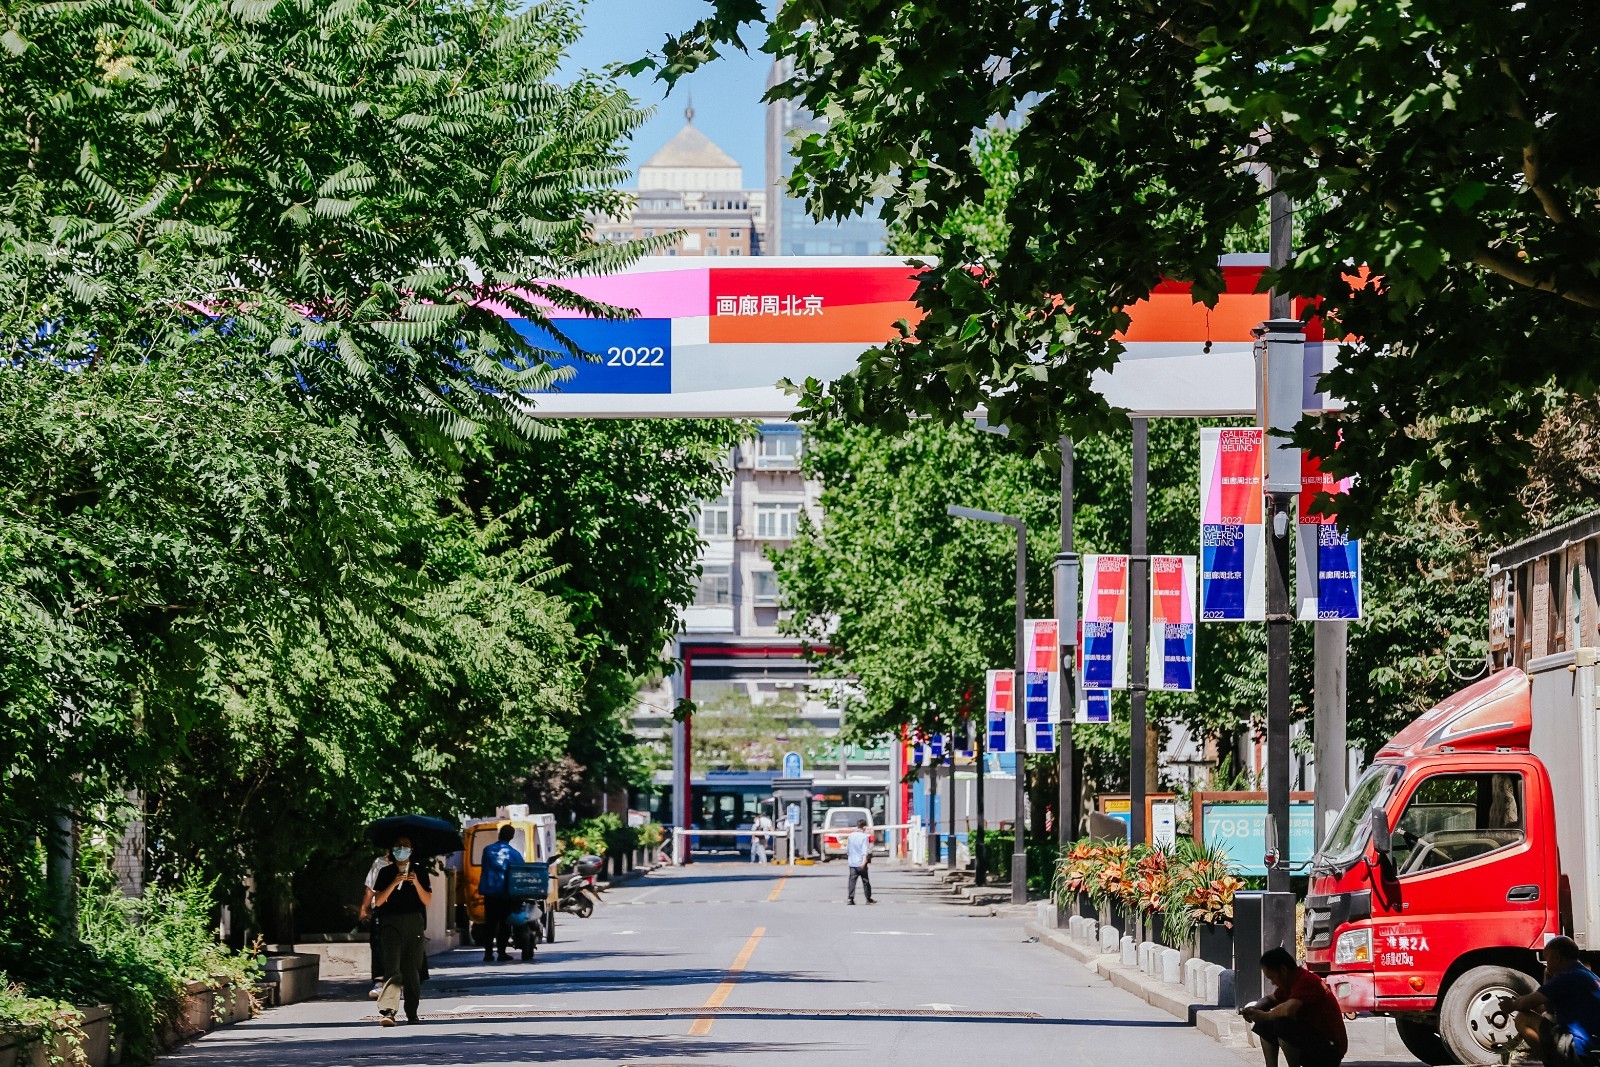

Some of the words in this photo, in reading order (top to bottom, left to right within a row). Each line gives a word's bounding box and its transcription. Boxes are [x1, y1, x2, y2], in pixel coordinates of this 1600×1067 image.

[715, 294, 824, 317] 画廊周北京
[606, 346, 665, 367] 2022
[1221, 430, 1259, 438] GALLERY
[1221, 437, 1262, 445] WEEKEND
[1221, 444, 1253, 452] BEIJING
[1221, 516, 1242, 524] 2022
[1299, 516, 1321, 524] 2022
[1203, 524, 1240, 532] GALLERY
[1203, 539, 1235, 547] BEIJING
[1318, 538, 1349, 546] BEIJING
[1203, 610, 1225, 619] 2022
[1318, 610, 1339, 619] 2022
[1207, 819, 1249, 838] 798
